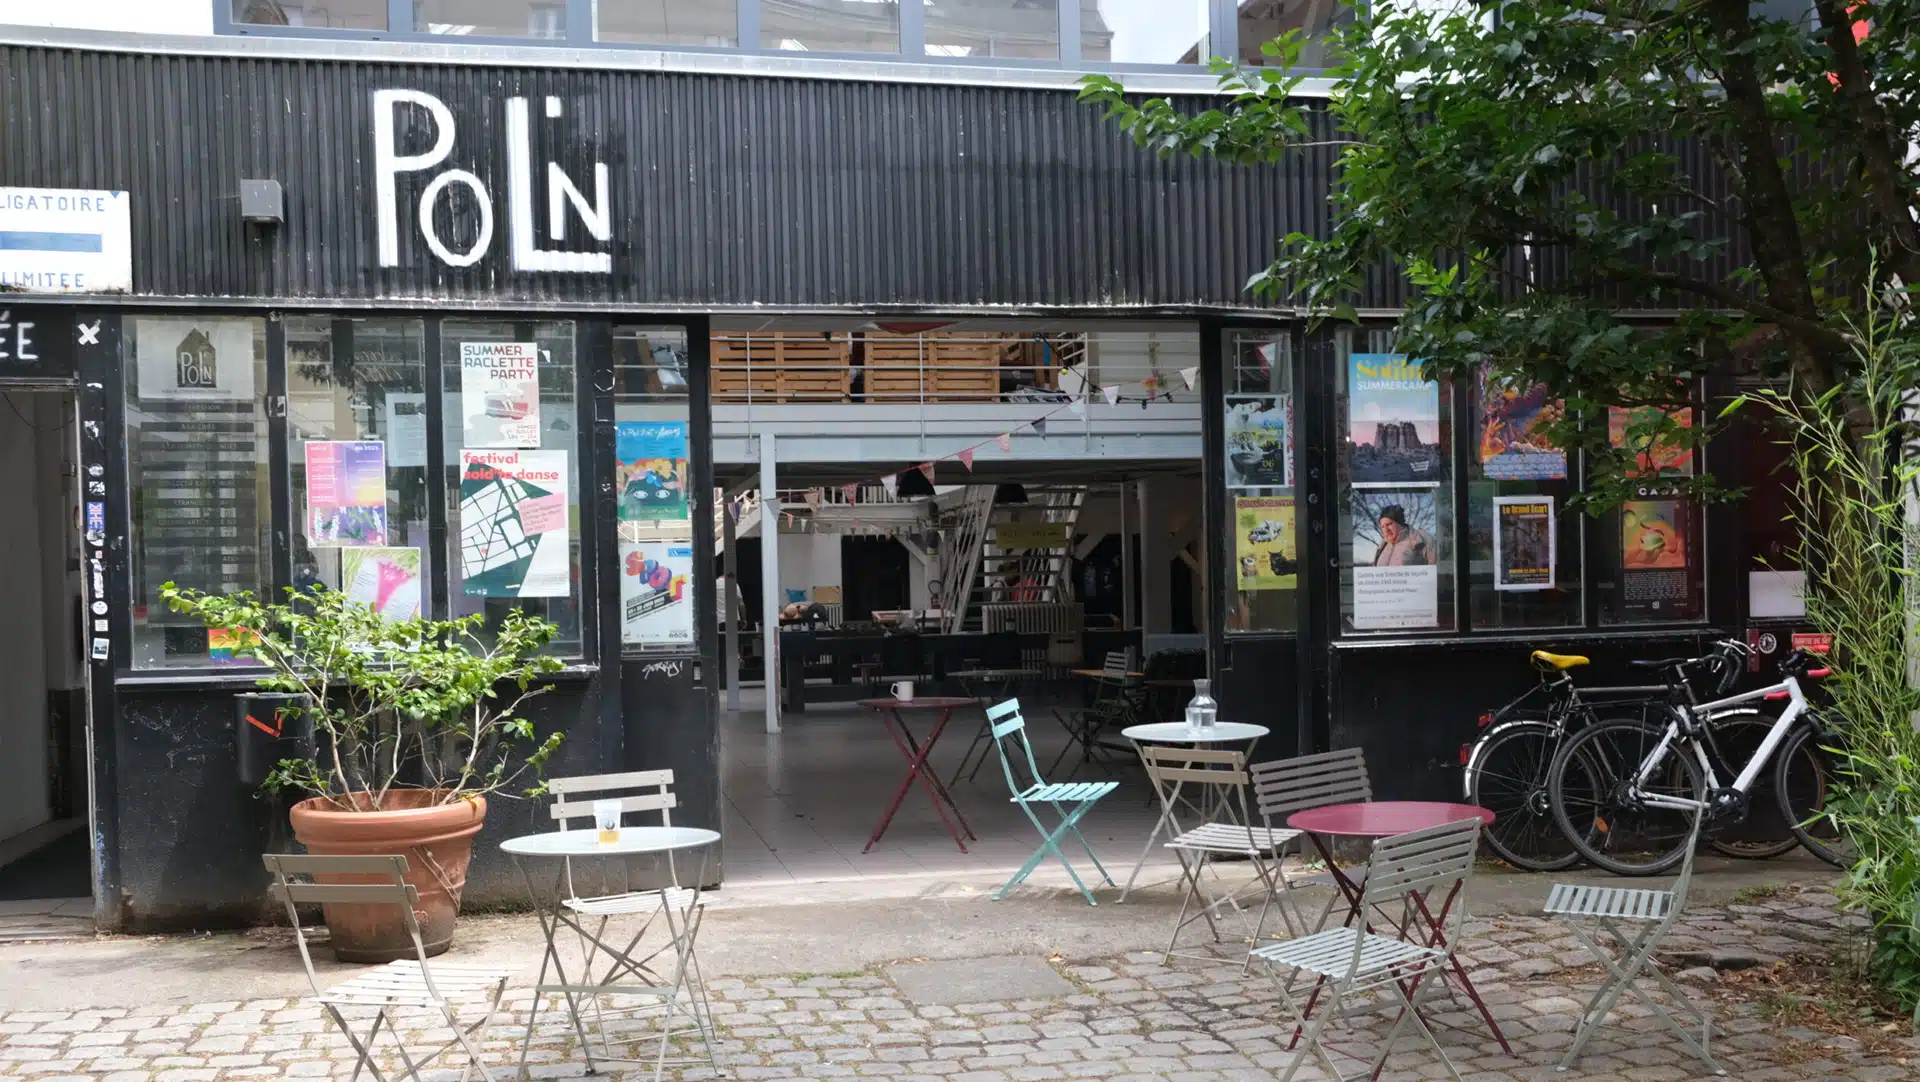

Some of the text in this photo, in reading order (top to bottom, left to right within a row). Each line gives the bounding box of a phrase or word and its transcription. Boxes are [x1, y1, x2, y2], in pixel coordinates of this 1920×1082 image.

[464, 345, 522, 356] SUMMER
[464, 357, 535, 368] RACLETTE
[490, 369, 535, 380] PARTY
[464, 452, 519, 464] festival
[516, 468, 559, 480] danse
